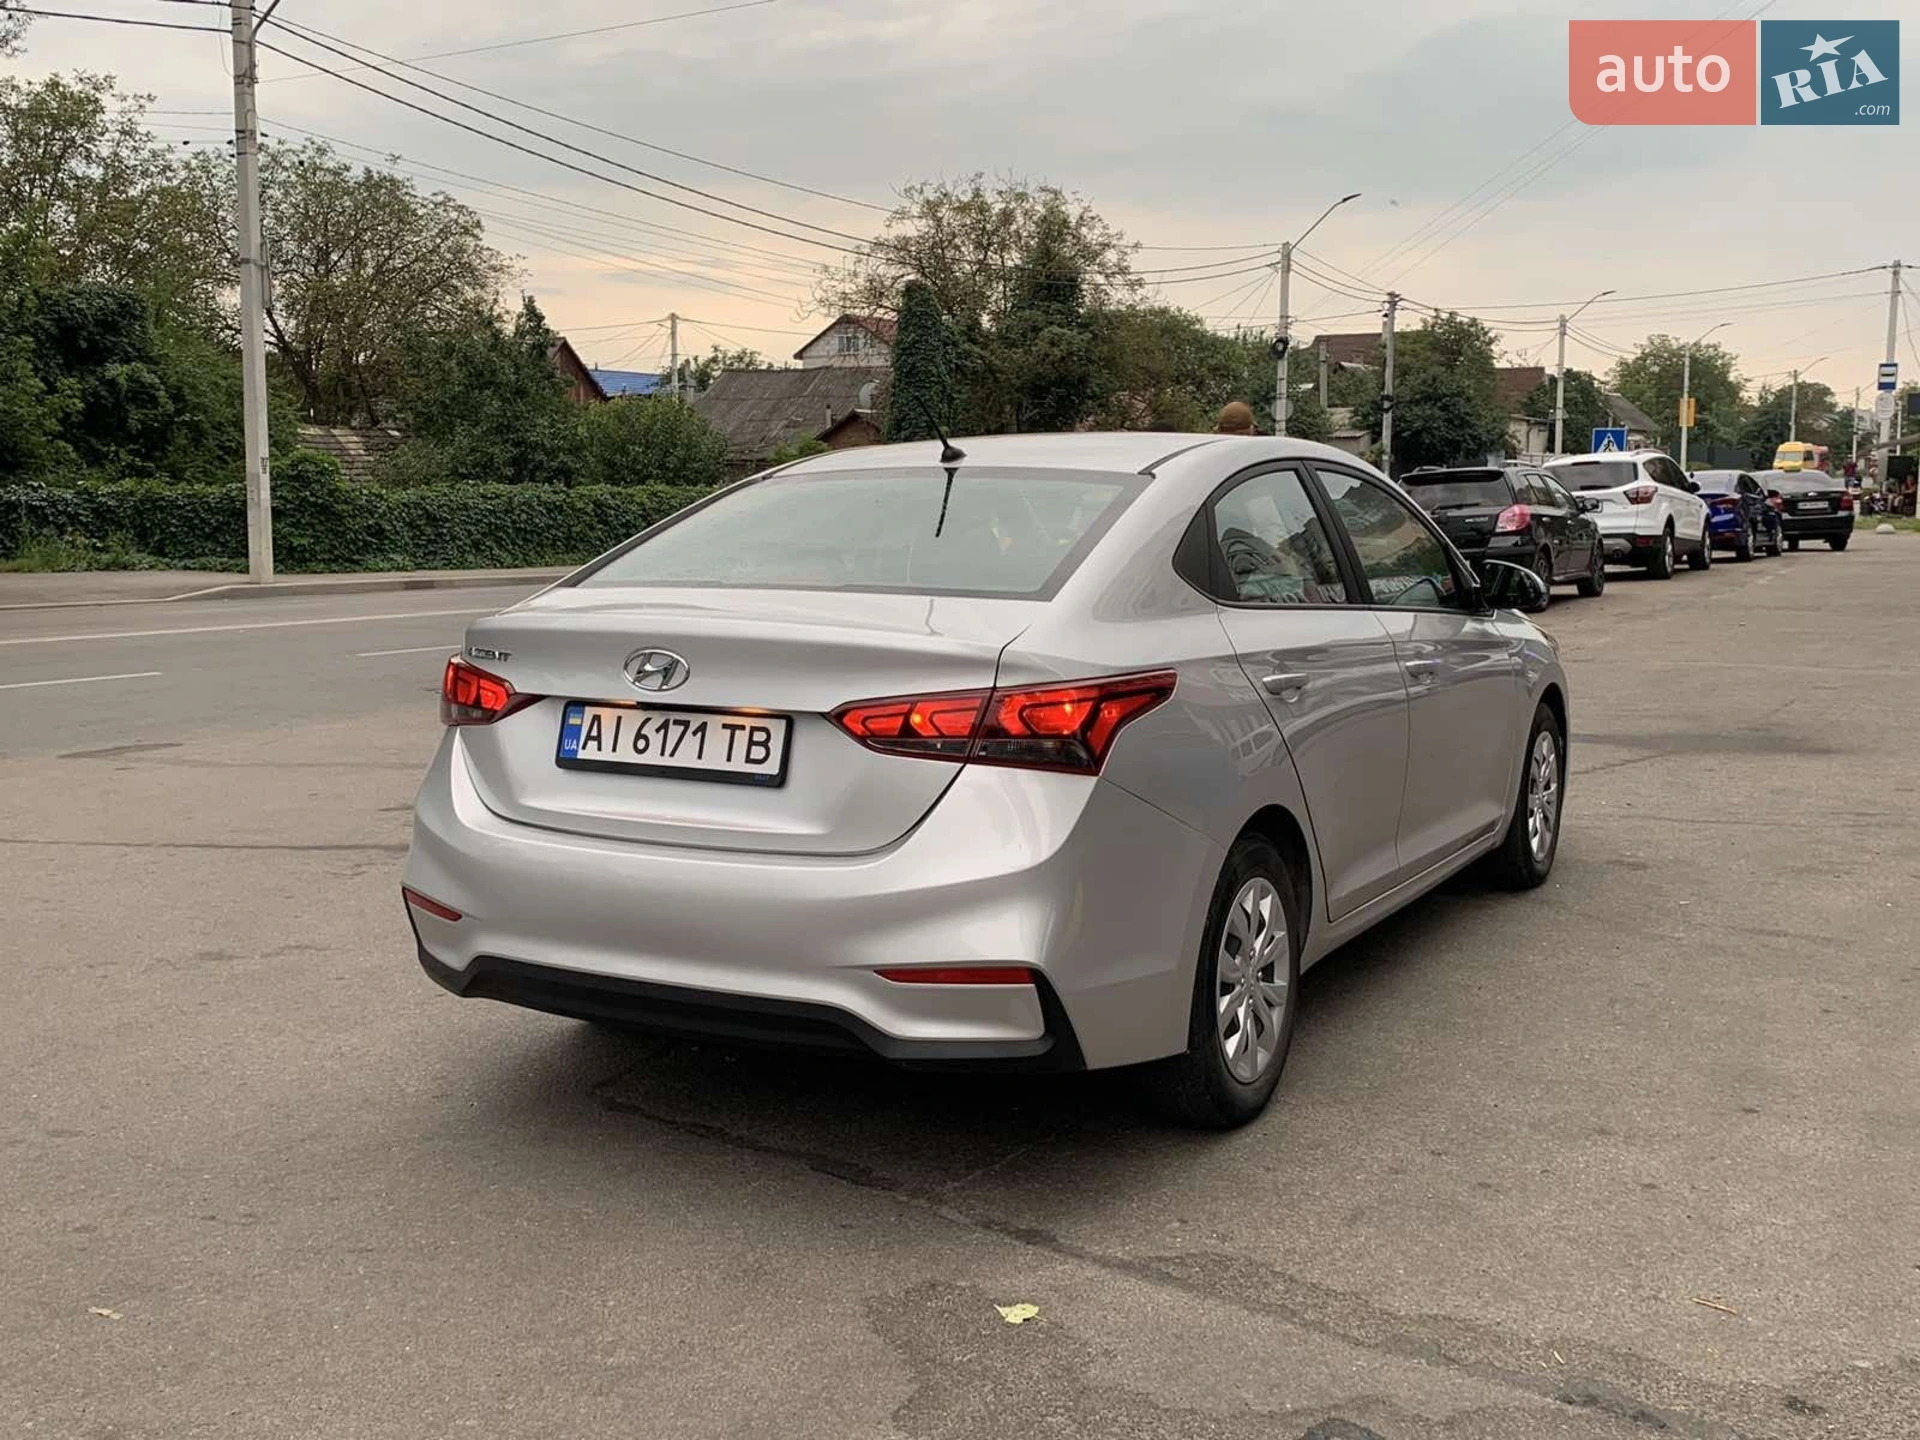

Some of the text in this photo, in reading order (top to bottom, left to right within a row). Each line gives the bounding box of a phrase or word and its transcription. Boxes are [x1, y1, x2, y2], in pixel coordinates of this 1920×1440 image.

[564, 738, 577, 751] UA
[581, 713, 772, 766] AI 6171 TB
